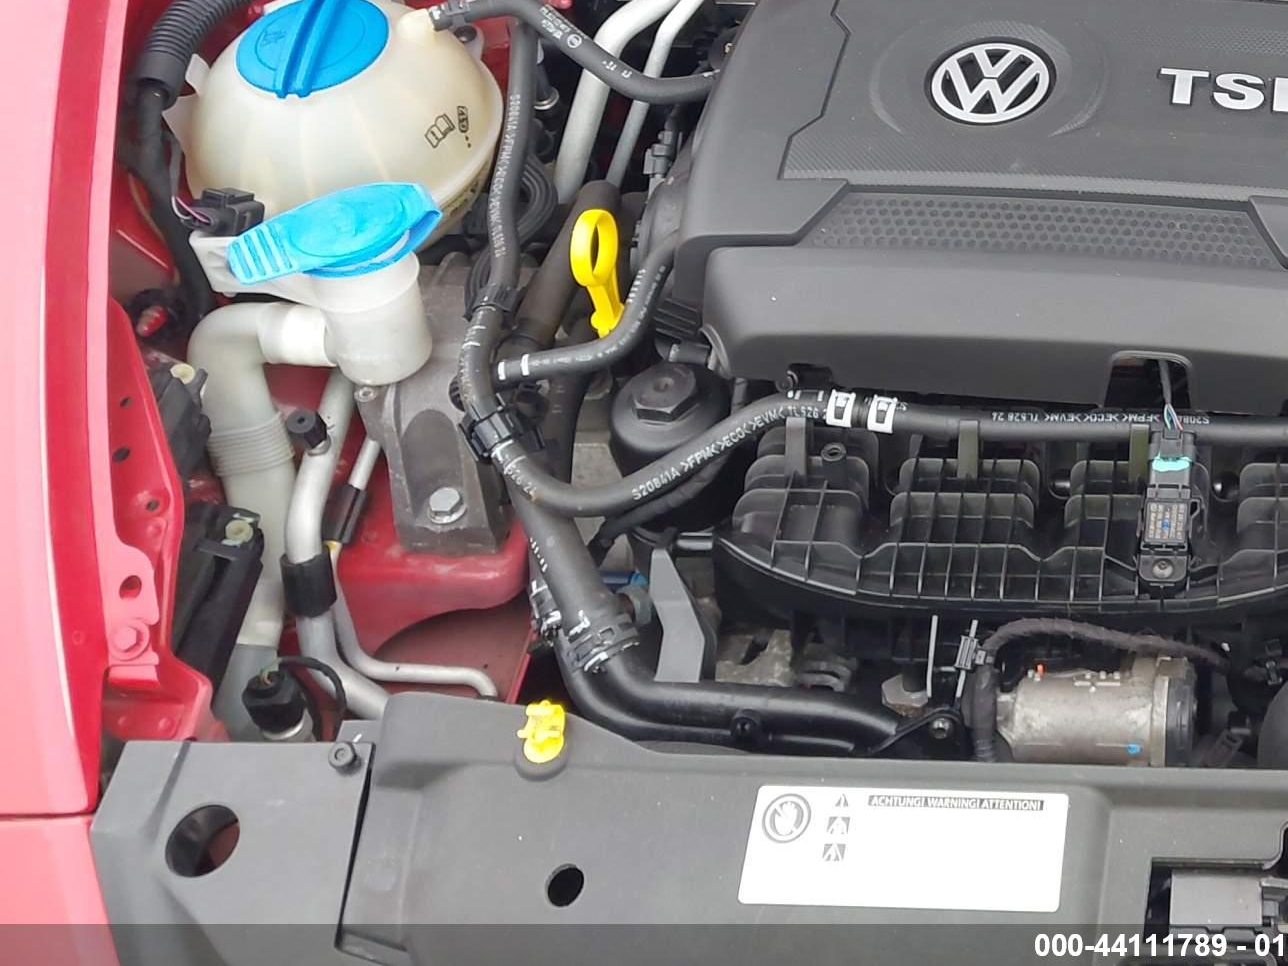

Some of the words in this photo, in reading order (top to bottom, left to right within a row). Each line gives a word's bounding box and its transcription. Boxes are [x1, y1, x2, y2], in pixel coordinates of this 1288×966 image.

[632, 467, 680, 501] S20841A
[871, 795, 925, 808] ACHTUNG!
[927, 796, 979, 809] WARNING!
[981, 798, 1042, 811] ATTENTION!
